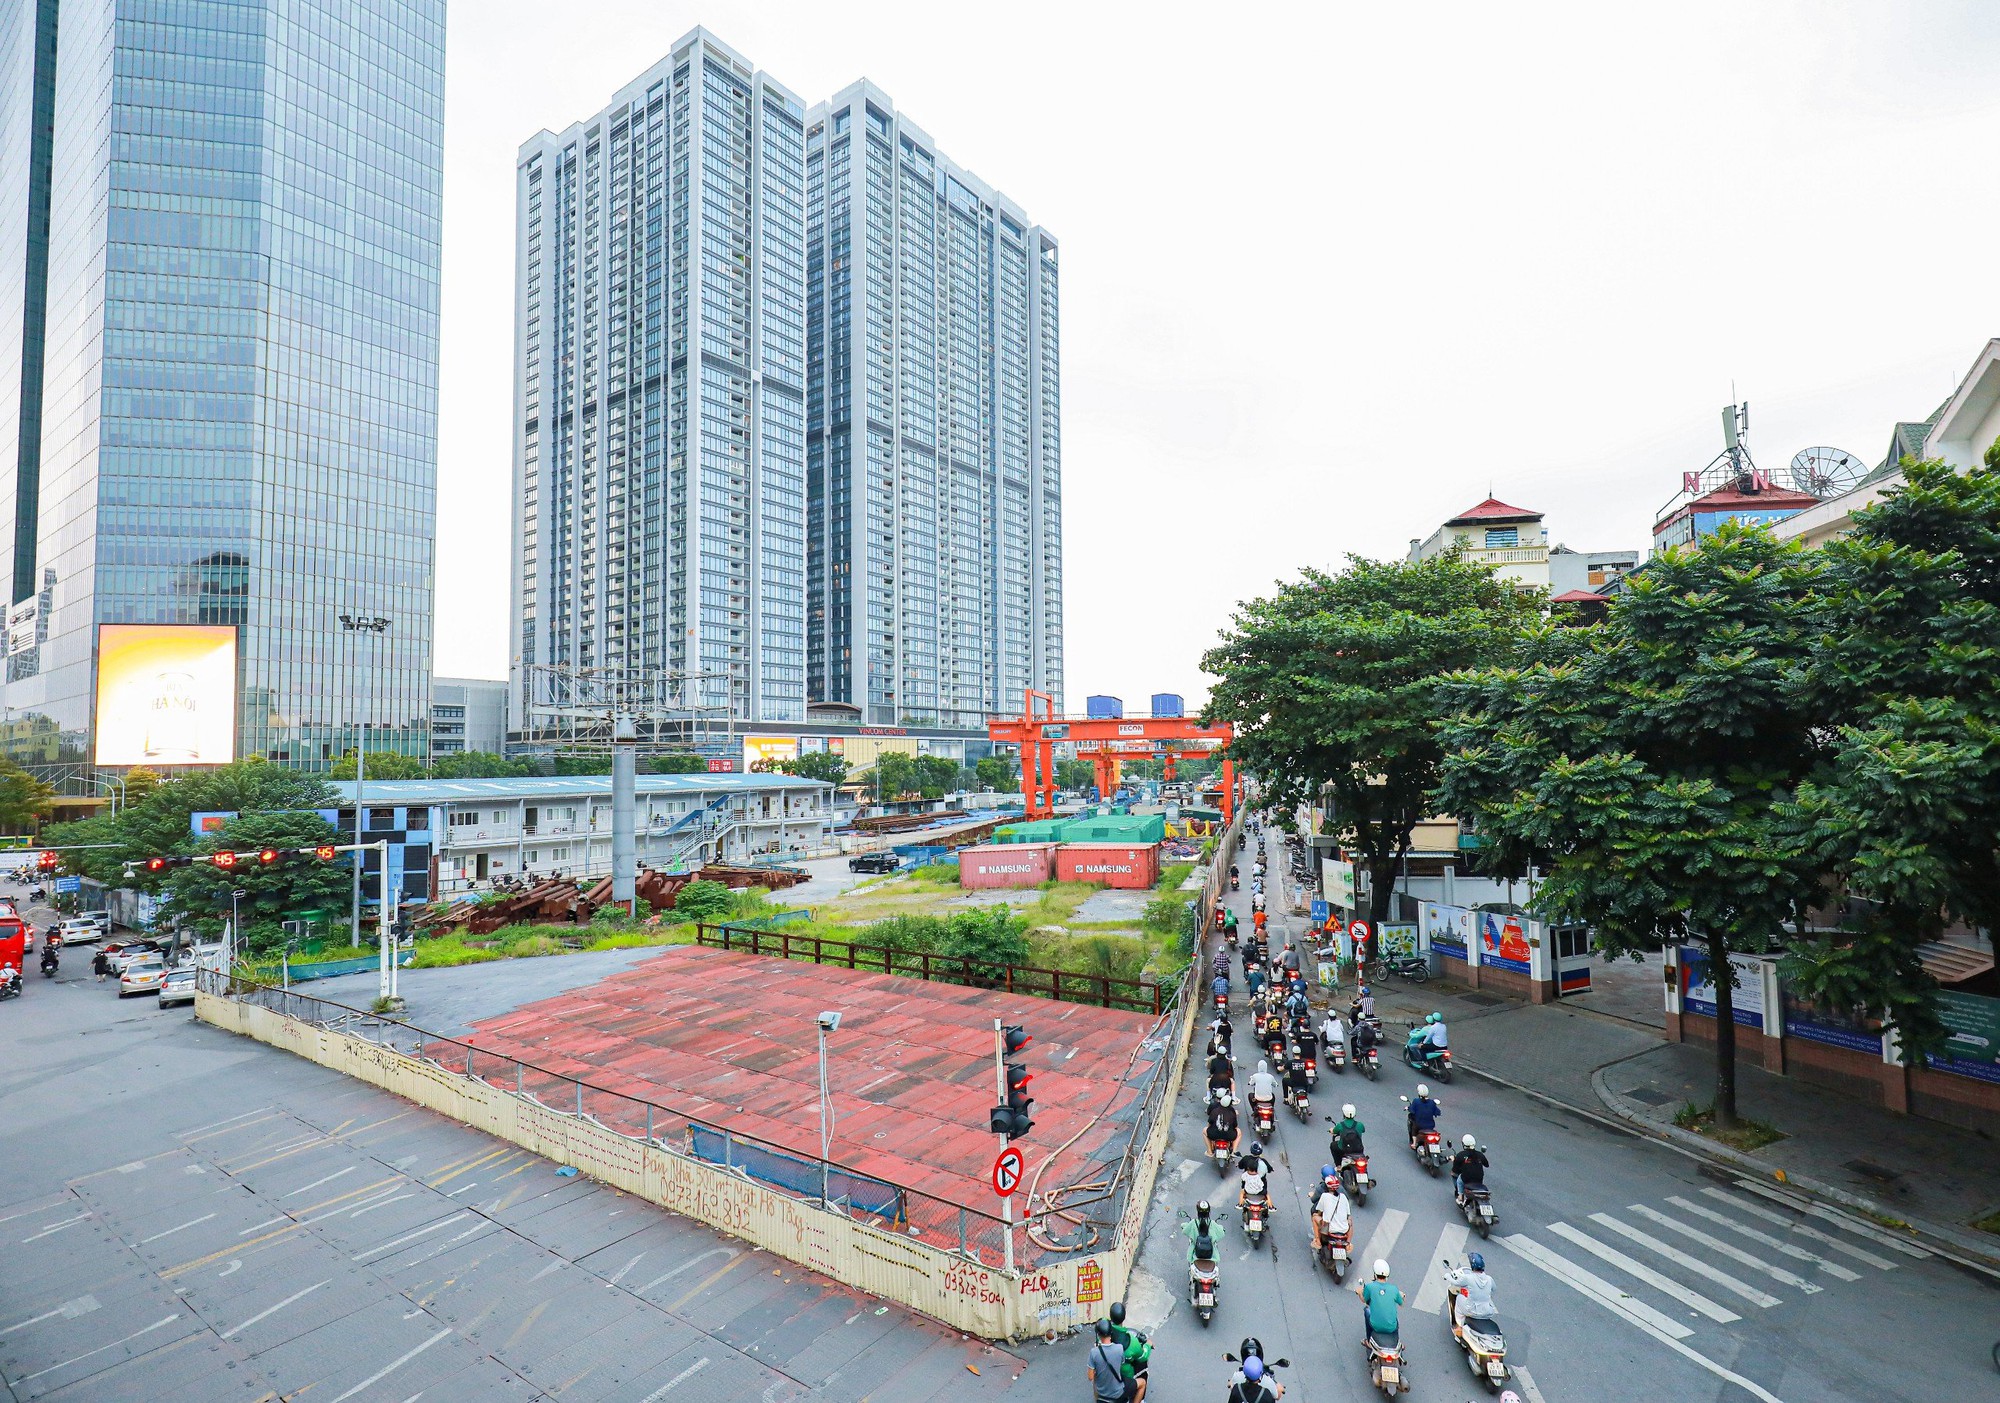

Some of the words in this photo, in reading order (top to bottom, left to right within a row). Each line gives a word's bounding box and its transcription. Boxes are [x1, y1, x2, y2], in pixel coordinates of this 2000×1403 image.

[858, 727, 884, 735] VINCOM
[884, 728, 907, 736] CENTER
[317, 847, 333, 858] 45
[215, 854, 233, 866] 45
[988, 865, 1031, 874] NAMSUNG
[1086, 865, 1132, 873] NAMSUNG
[1084, 1281, 1090, 1291] 5
